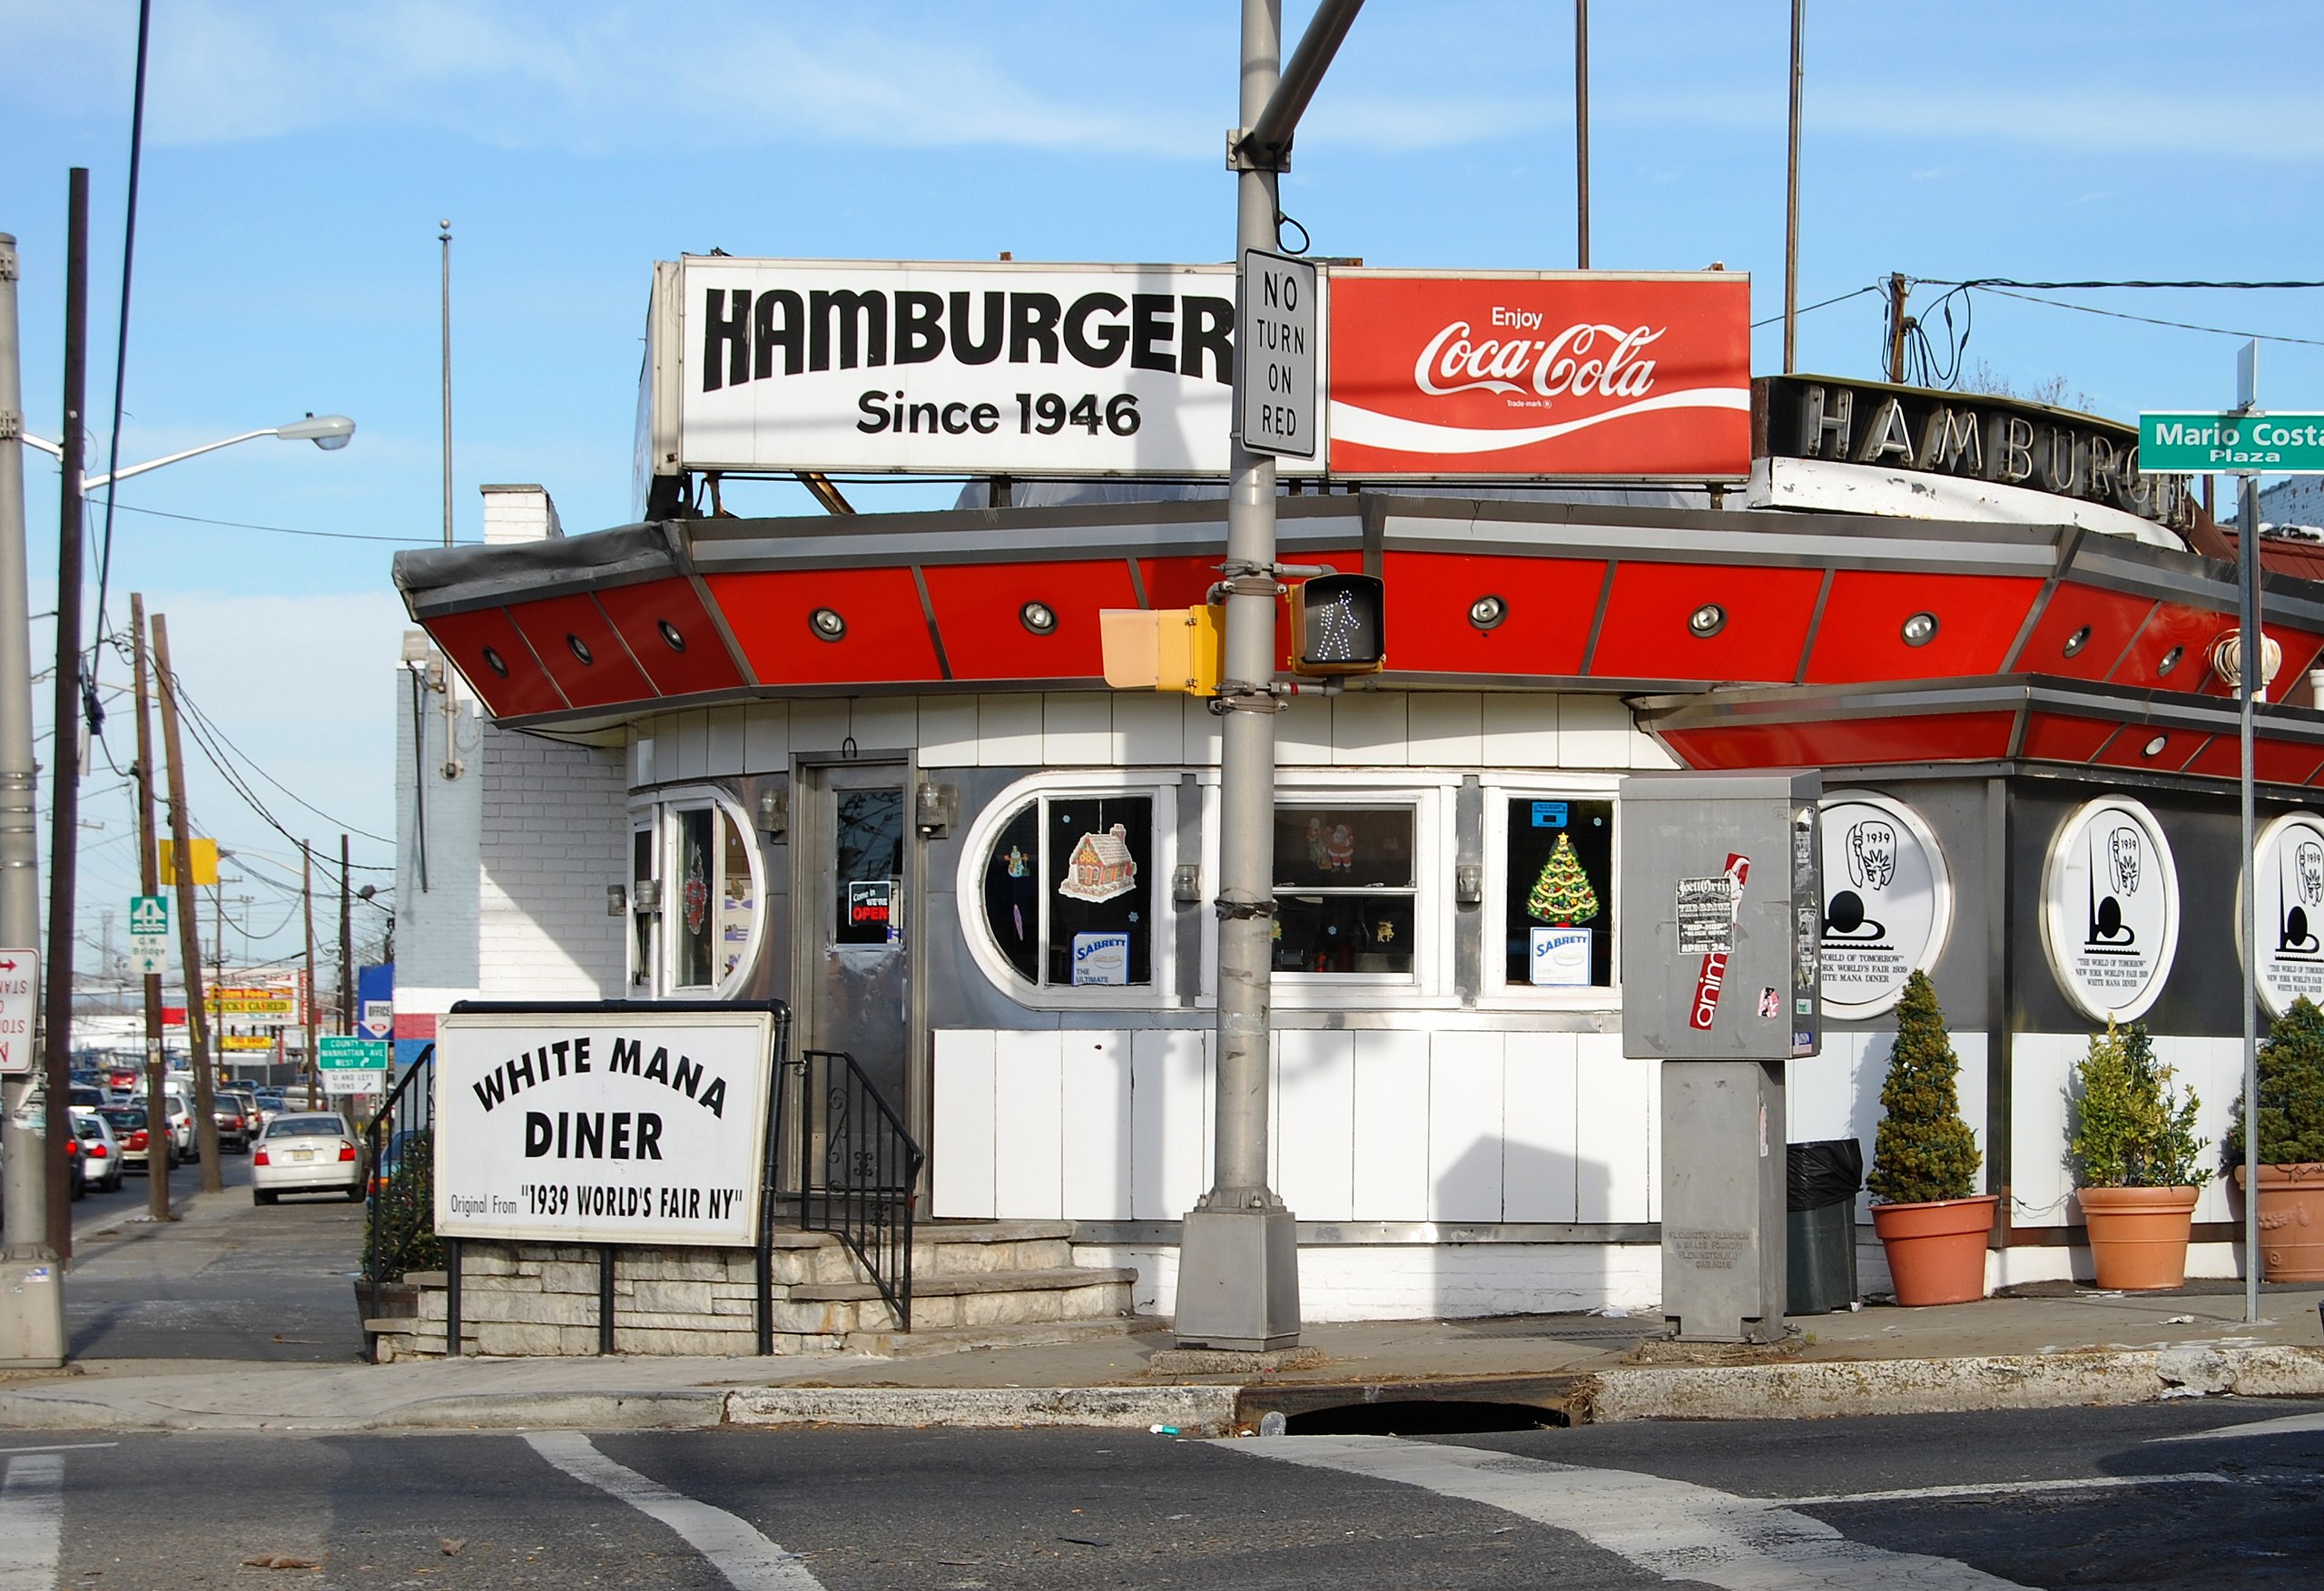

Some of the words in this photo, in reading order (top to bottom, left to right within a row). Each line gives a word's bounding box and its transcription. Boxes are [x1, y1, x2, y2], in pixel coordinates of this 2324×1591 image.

[1265, 270, 1297, 312] NO
[1492, 307, 1543, 330] Enjoy
[1257, 319, 1305, 355] TURN
[1414, 321, 1667, 397] Coca-Cola
[1268, 363, 1291, 394] ON
[856, 390, 999, 434] Since
[1016, 393, 1141, 436] 1946
[1262, 404, 1296, 437] RED
[2156, 422, 2240, 446] Mario
[2210, 449, 2280, 463] Plaza
[1866, 831, 1890, 844] 1939
[2122, 838, 2136, 850] 1939
[852, 906, 888, 920] OPEN
[133, 947, 165, 957] Bridge
[1078, 938, 1126, 960] SABRETT
[1536, 936, 1587, 958] SABRETT
[369, 1006, 390, 1016] OFFICE
[472, 1036, 591, 1113] WHITE
[609, 1036, 727, 1119] MANA
[525, 1111, 663, 1160] DINER
[450, 1193, 487, 1217] Original
[493, 1195, 517, 1214] From
[521, 1184, 568, 1215] "1939
[576, 1185, 653, 1217] WORLD'S
[660, 1187, 700, 1218] FAIR
[708, 1188, 743, 1219] NY"
